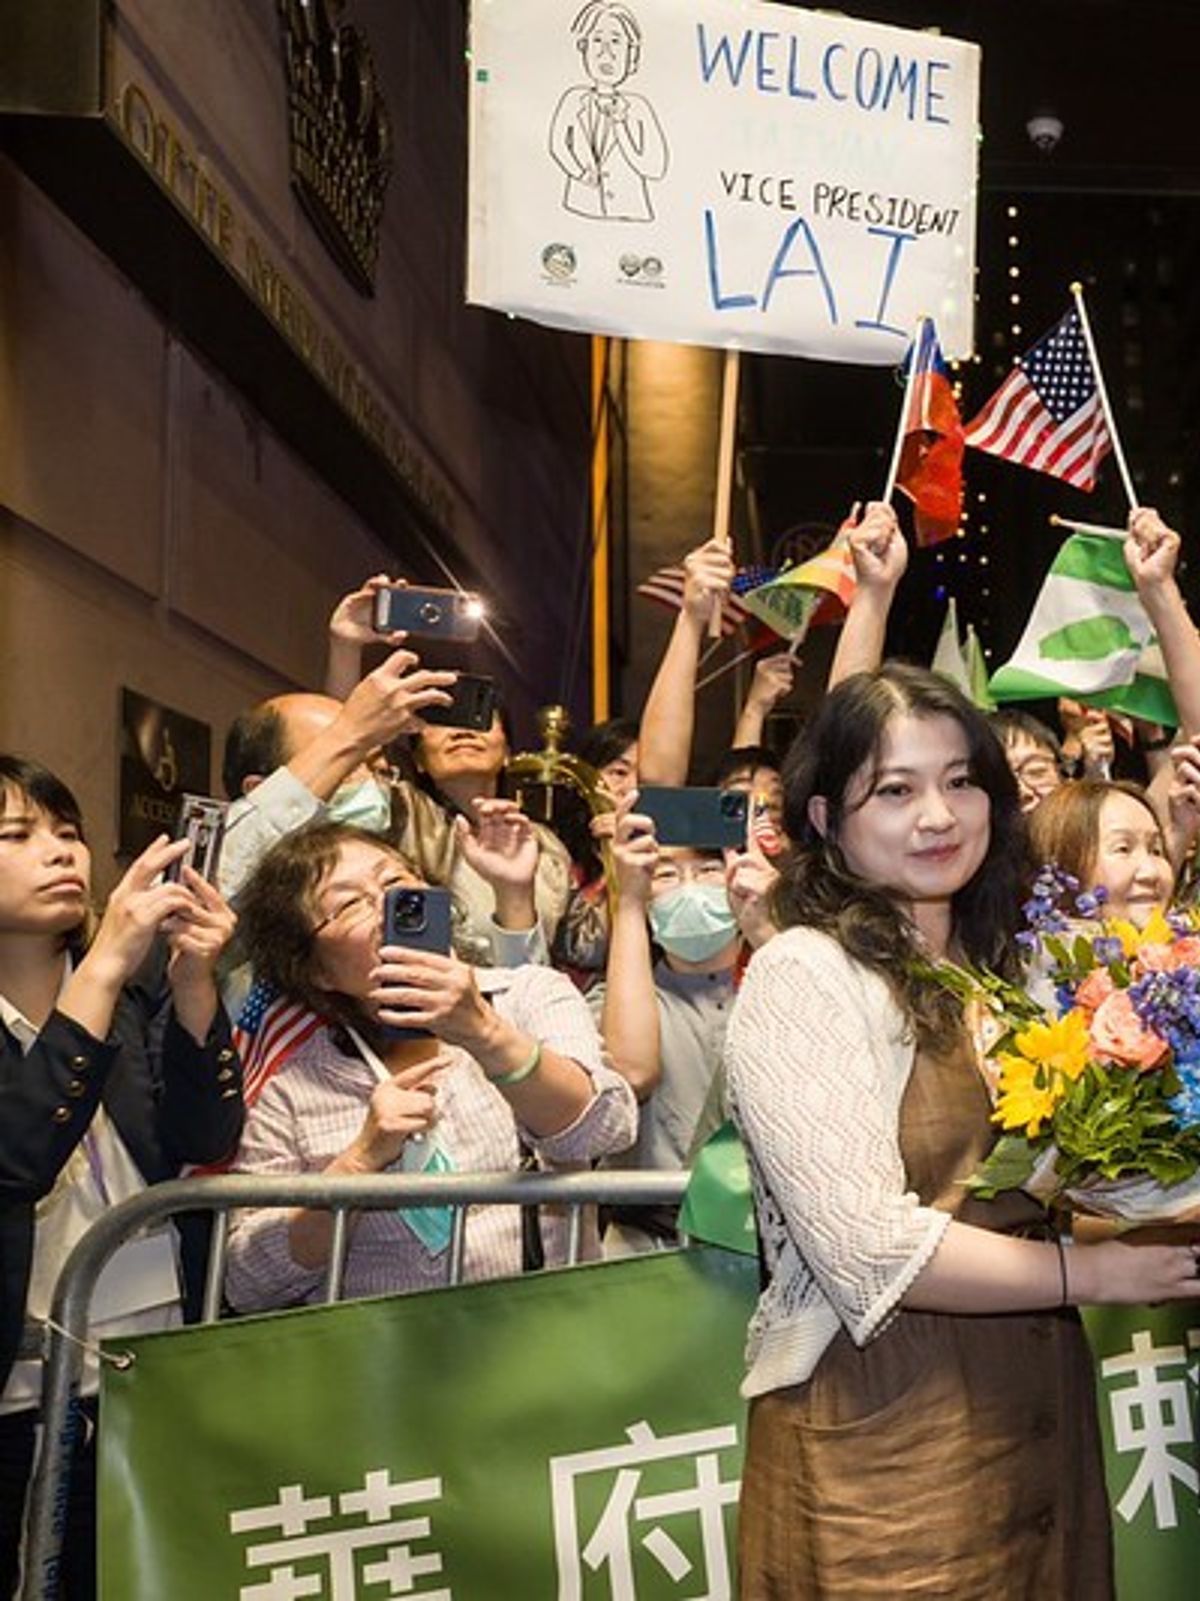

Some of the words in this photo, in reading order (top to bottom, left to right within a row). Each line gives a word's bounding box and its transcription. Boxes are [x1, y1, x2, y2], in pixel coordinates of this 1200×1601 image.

[697, 23, 950, 124] WELCOME
[121, 82, 232, 254] OTTE
[720, 171, 797, 210] VICE
[813, 182, 960, 235] PRESIDENT
[705, 209, 918, 337] LAI
